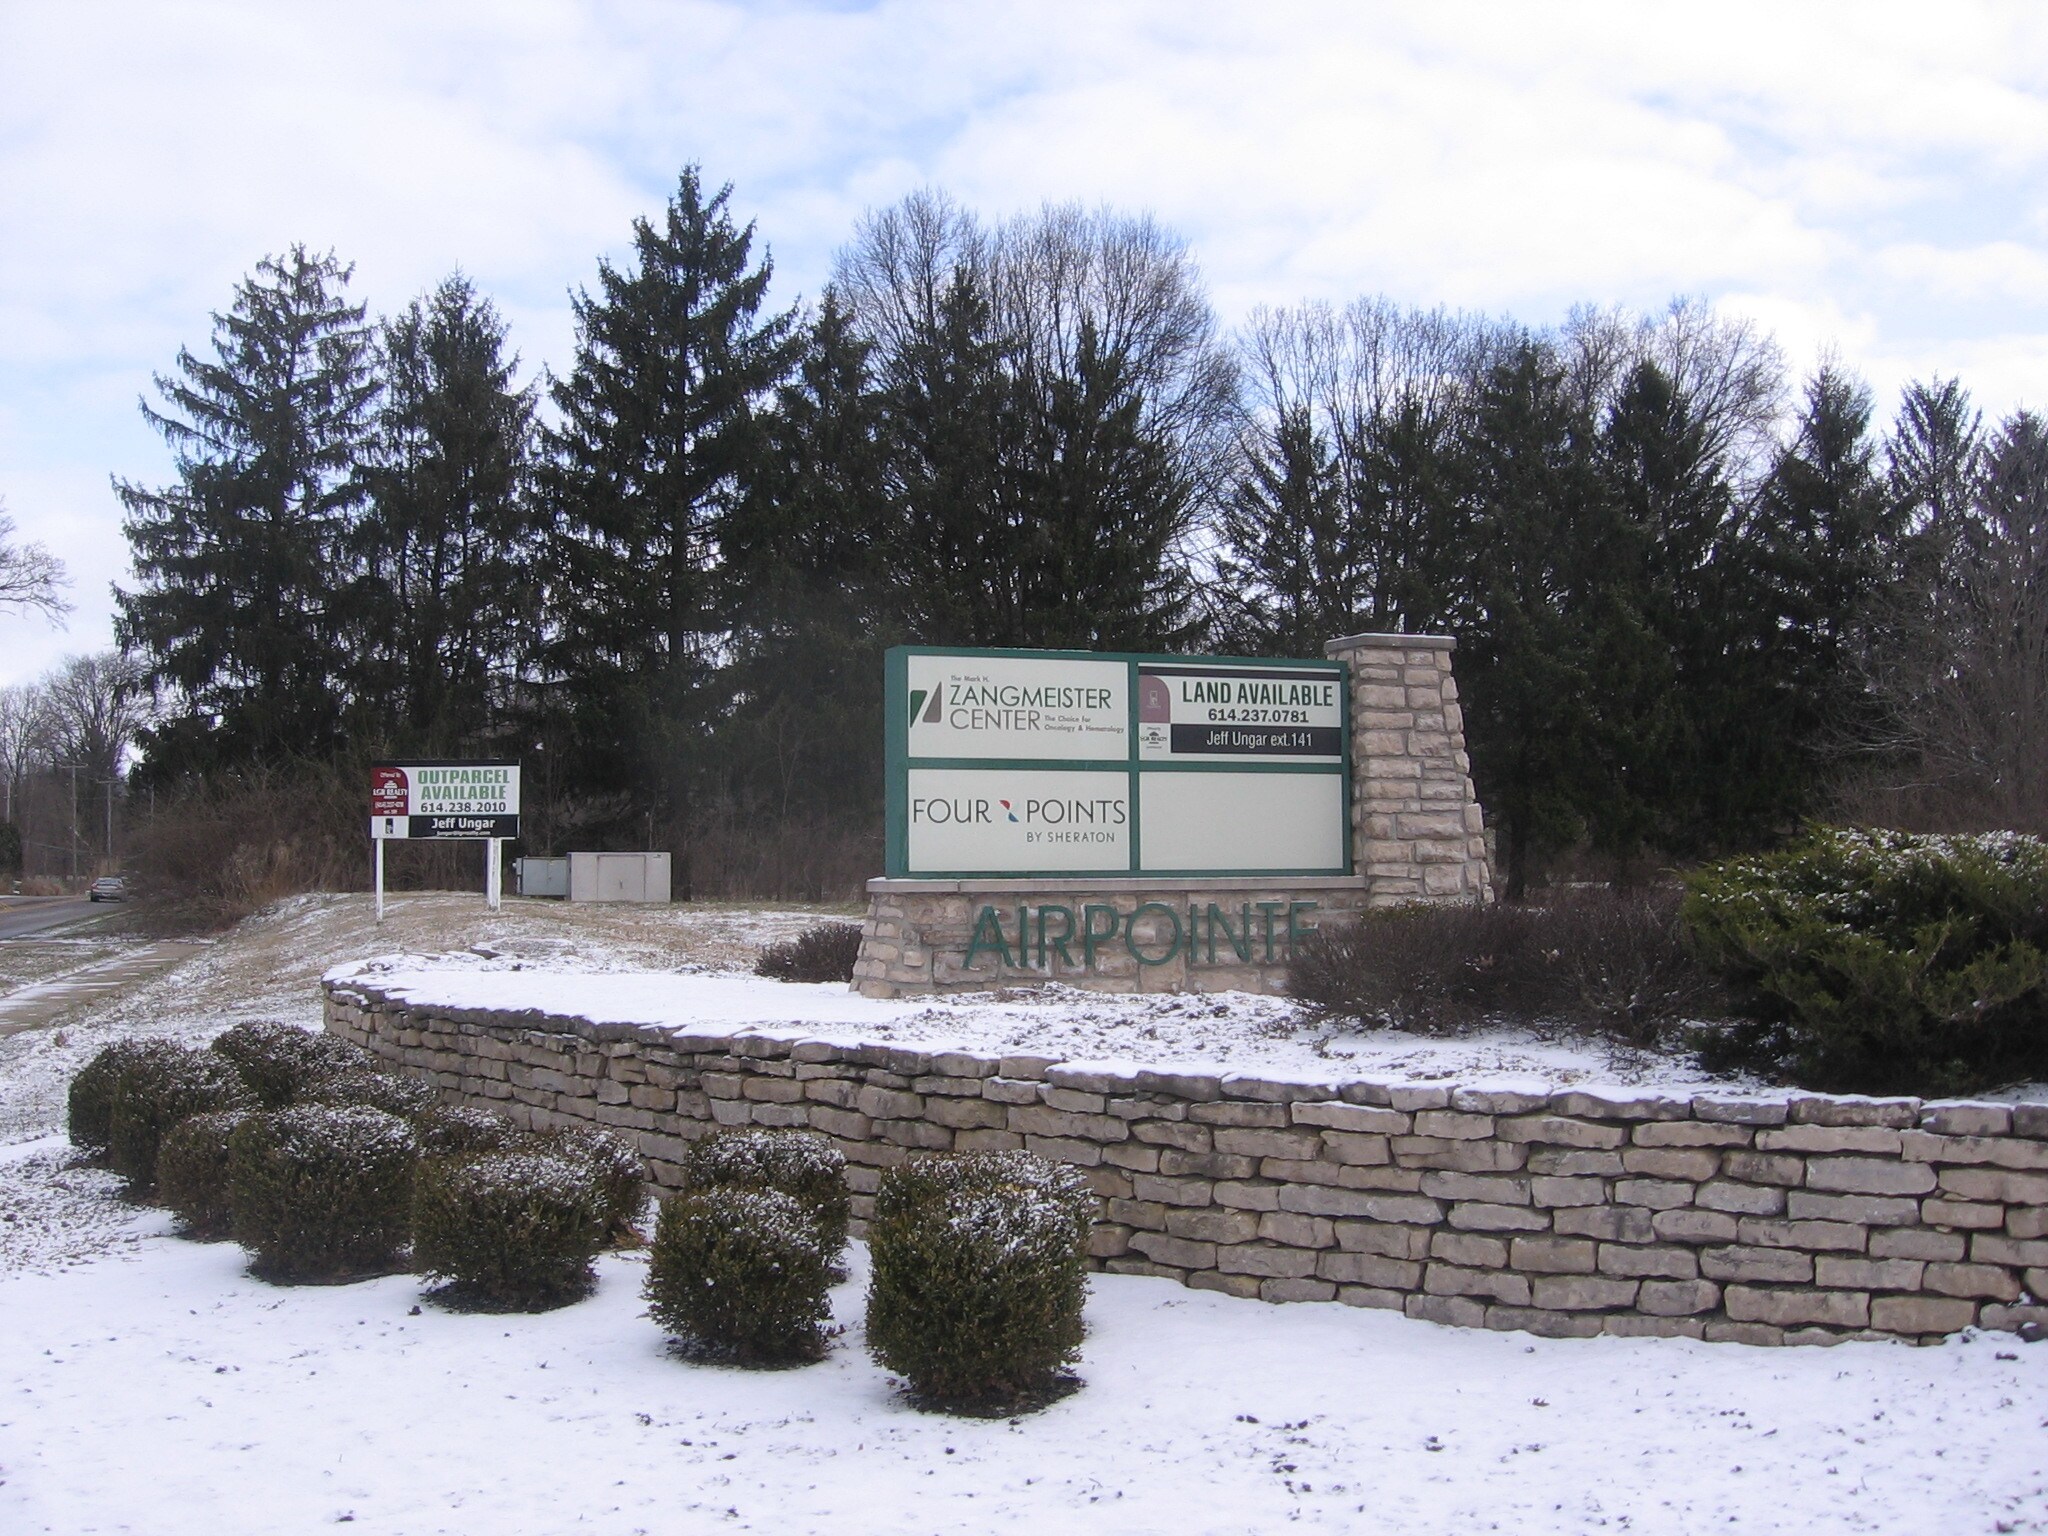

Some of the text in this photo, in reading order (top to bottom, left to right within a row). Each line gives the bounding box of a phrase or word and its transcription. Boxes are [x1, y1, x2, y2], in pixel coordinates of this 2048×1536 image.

[950, 685, 1112, 709] ZANGMEISTER
[1182, 681, 1334, 707] LAND AVAILABLE
[950, 709, 1041, 730] CENTER
[1208, 708, 1309, 723] 614.237.0781
[1207, 730, 1229, 746] Jeff
[1232, 732, 1268, 748] Ungar
[418, 769, 510, 784] OUTPARCEL
[421, 785, 507, 800] AVAILABLE
[420, 802, 507, 813] 614.238.2010
[913, 799, 1126, 824] FOUR POINTS
[431, 817, 496, 831] Jeff Ungar
[1026, 831, 1115, 843] BY SHERATON
